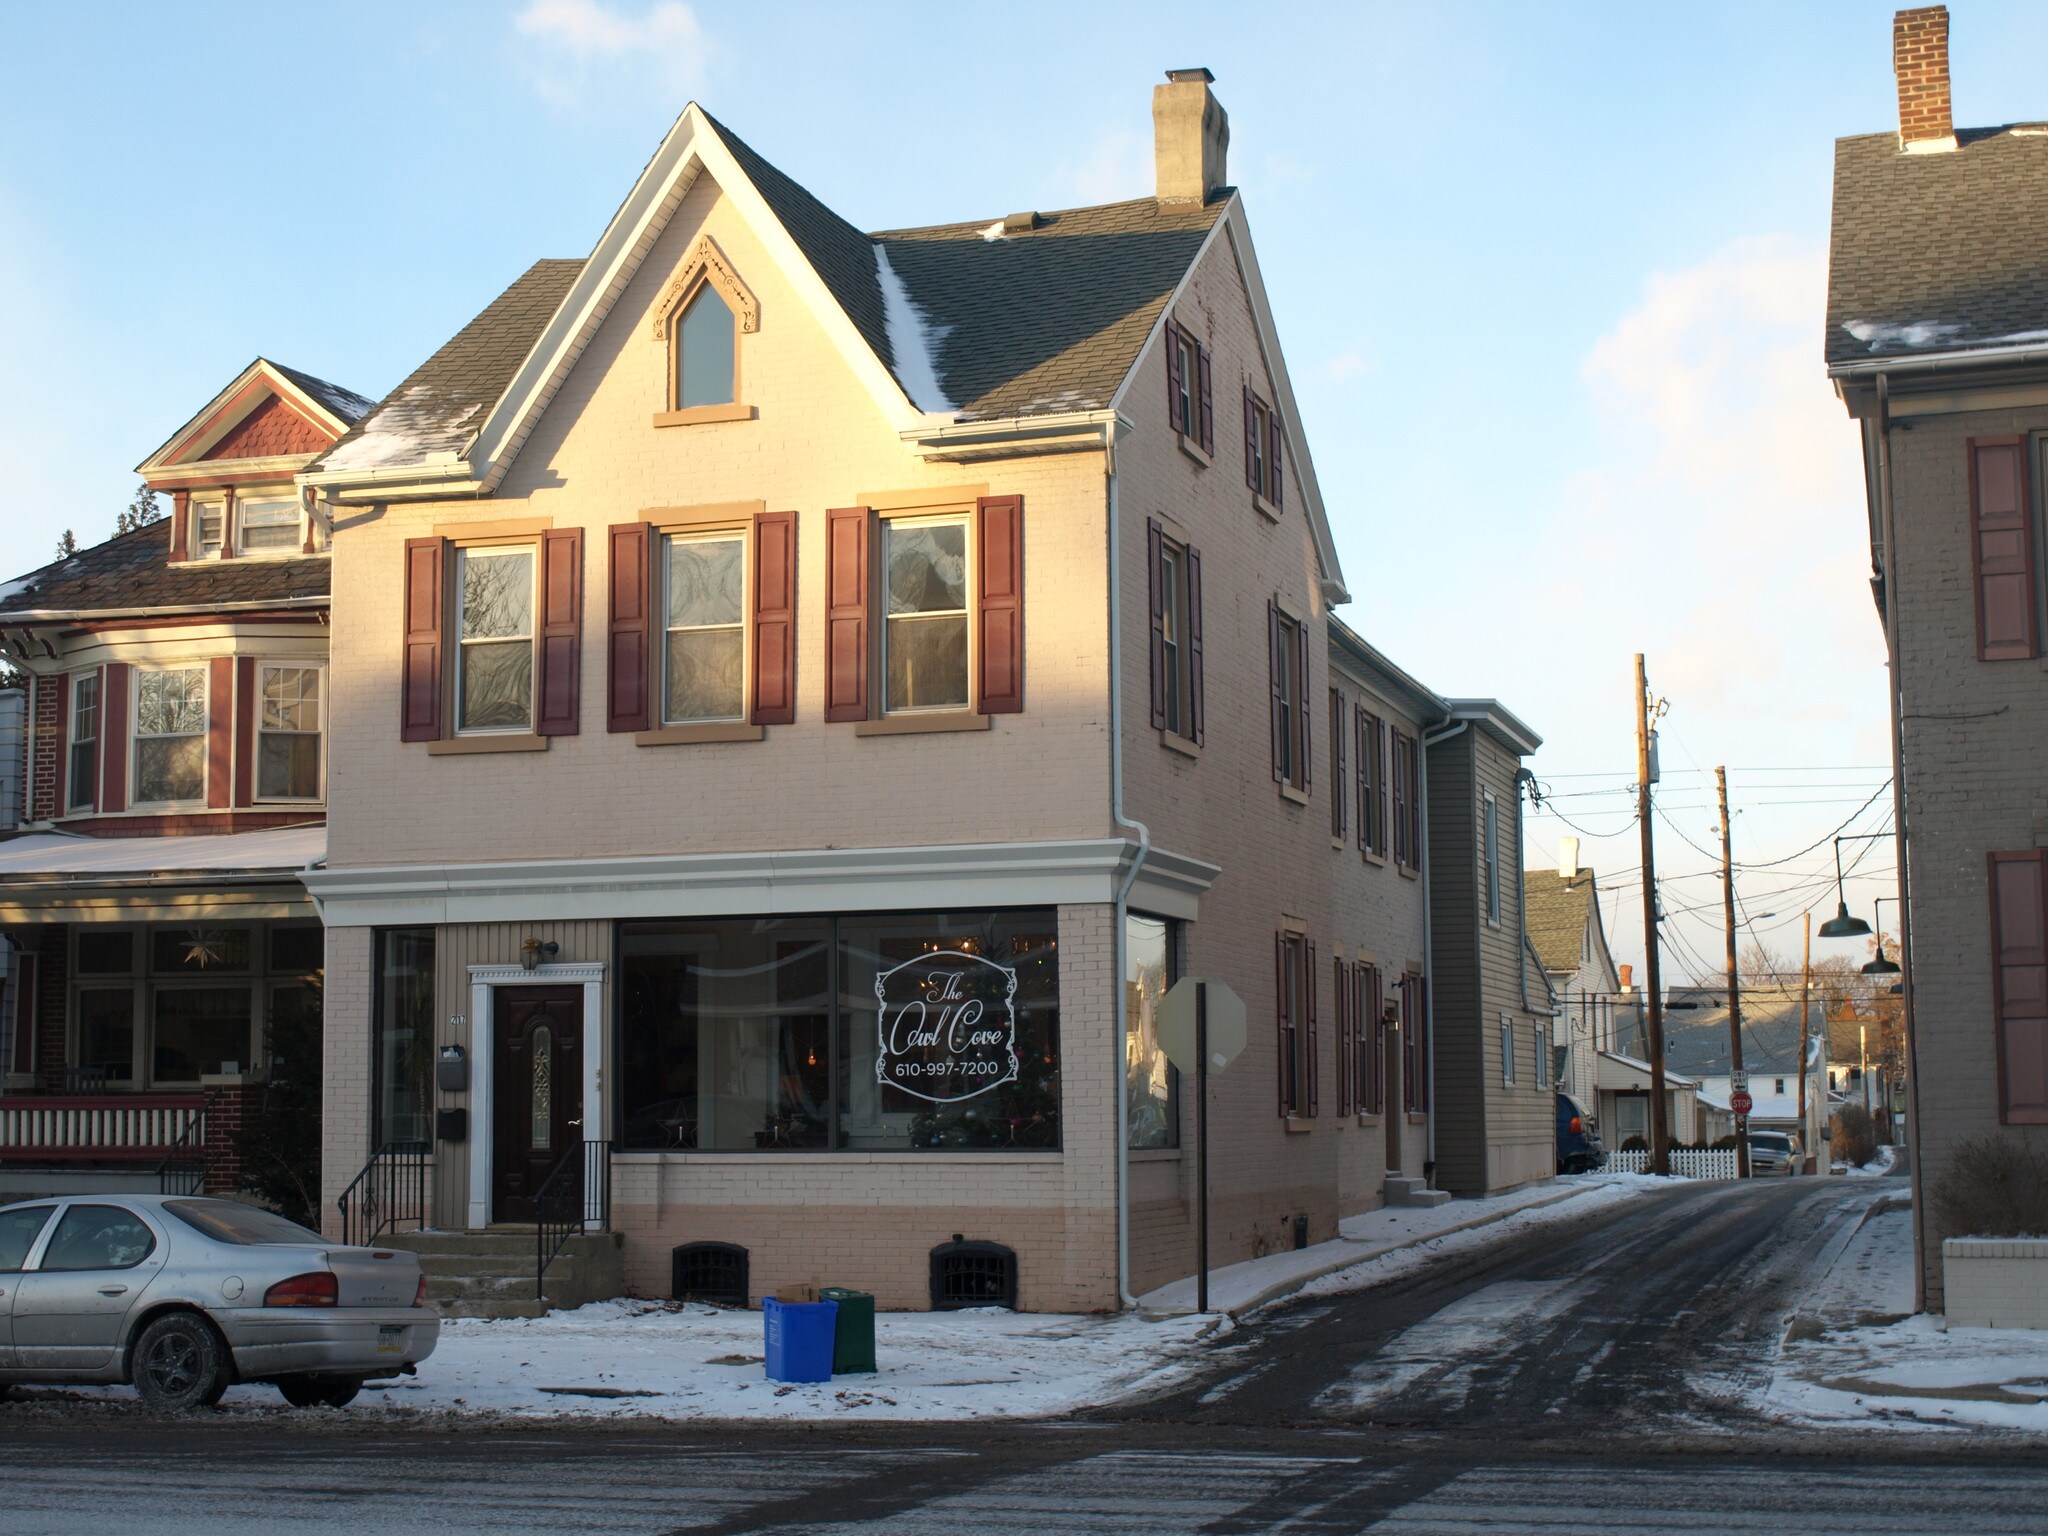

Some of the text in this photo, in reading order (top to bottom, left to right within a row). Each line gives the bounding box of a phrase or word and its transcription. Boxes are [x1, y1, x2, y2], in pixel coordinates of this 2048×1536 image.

[926, 971, 964, 1003] The
[450, 1014, 466, 1025] 217
[890, 999, 1003, 1055] Owl Cove
[895, 1061, 998, 1076] 610-997-7200
[1732, 1099, 1752, 1109] STOP
